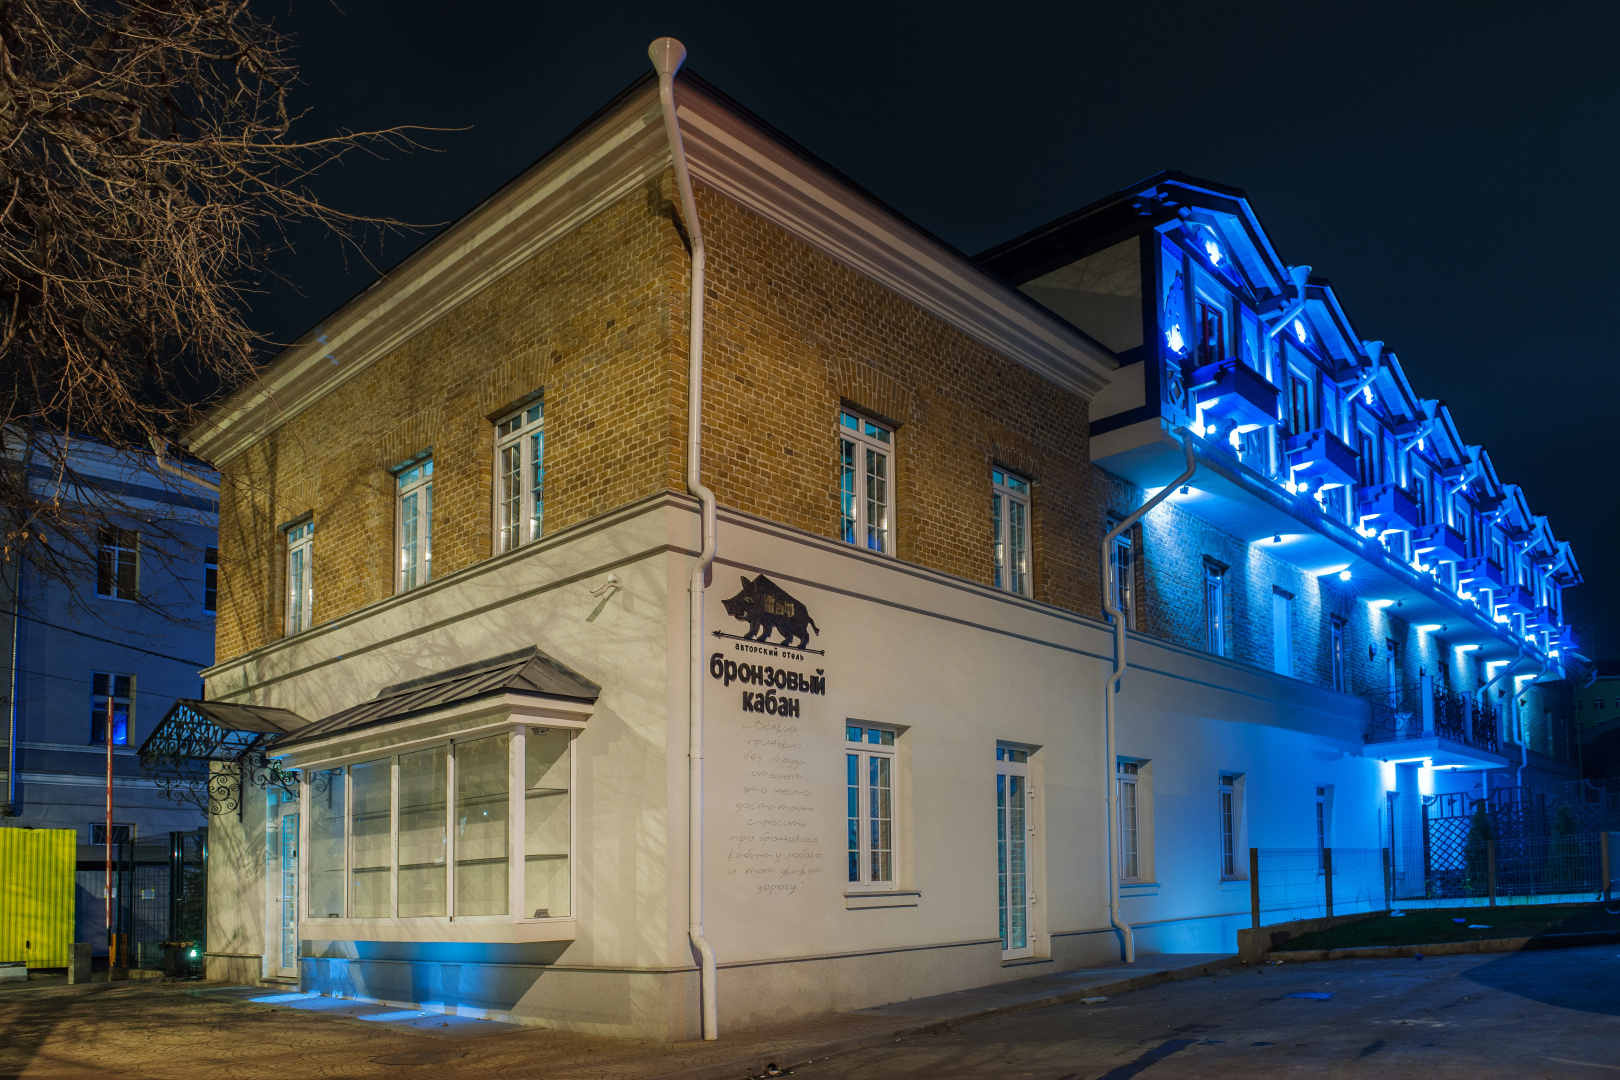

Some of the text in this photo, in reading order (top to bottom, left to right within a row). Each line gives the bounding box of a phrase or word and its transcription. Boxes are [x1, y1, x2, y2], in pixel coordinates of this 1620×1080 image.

[735, 643, 805, 661] авторский отель
[710, 652, 826, 696] бронзовый
[742, 689, 800, 718] кабан
[729, 835, 755, 848] про
